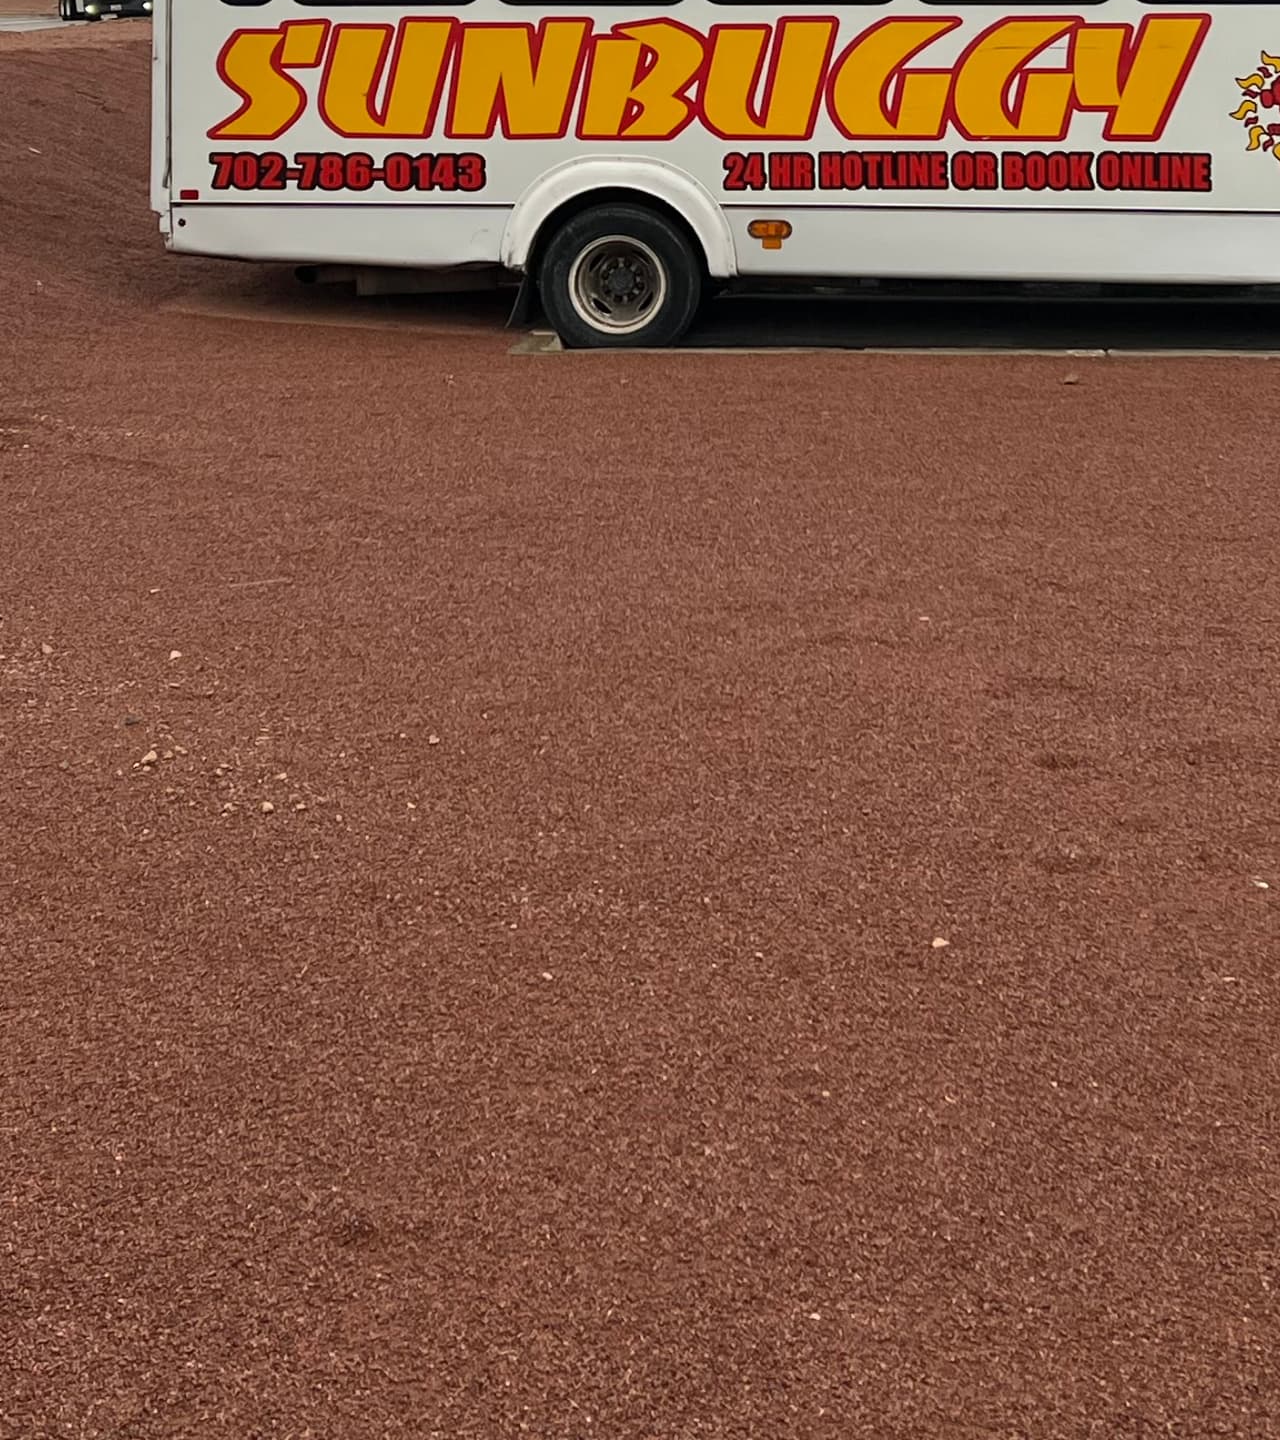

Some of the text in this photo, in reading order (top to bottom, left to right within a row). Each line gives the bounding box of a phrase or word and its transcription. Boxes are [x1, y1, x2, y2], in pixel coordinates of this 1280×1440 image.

[207, 13, 1212, 142] SUNBUGGY
[209, 152, 486, 192] 702-786-0143
[723, 151, 1212, 192] 24 HR HOTLINE OR BOOK ONLINE
